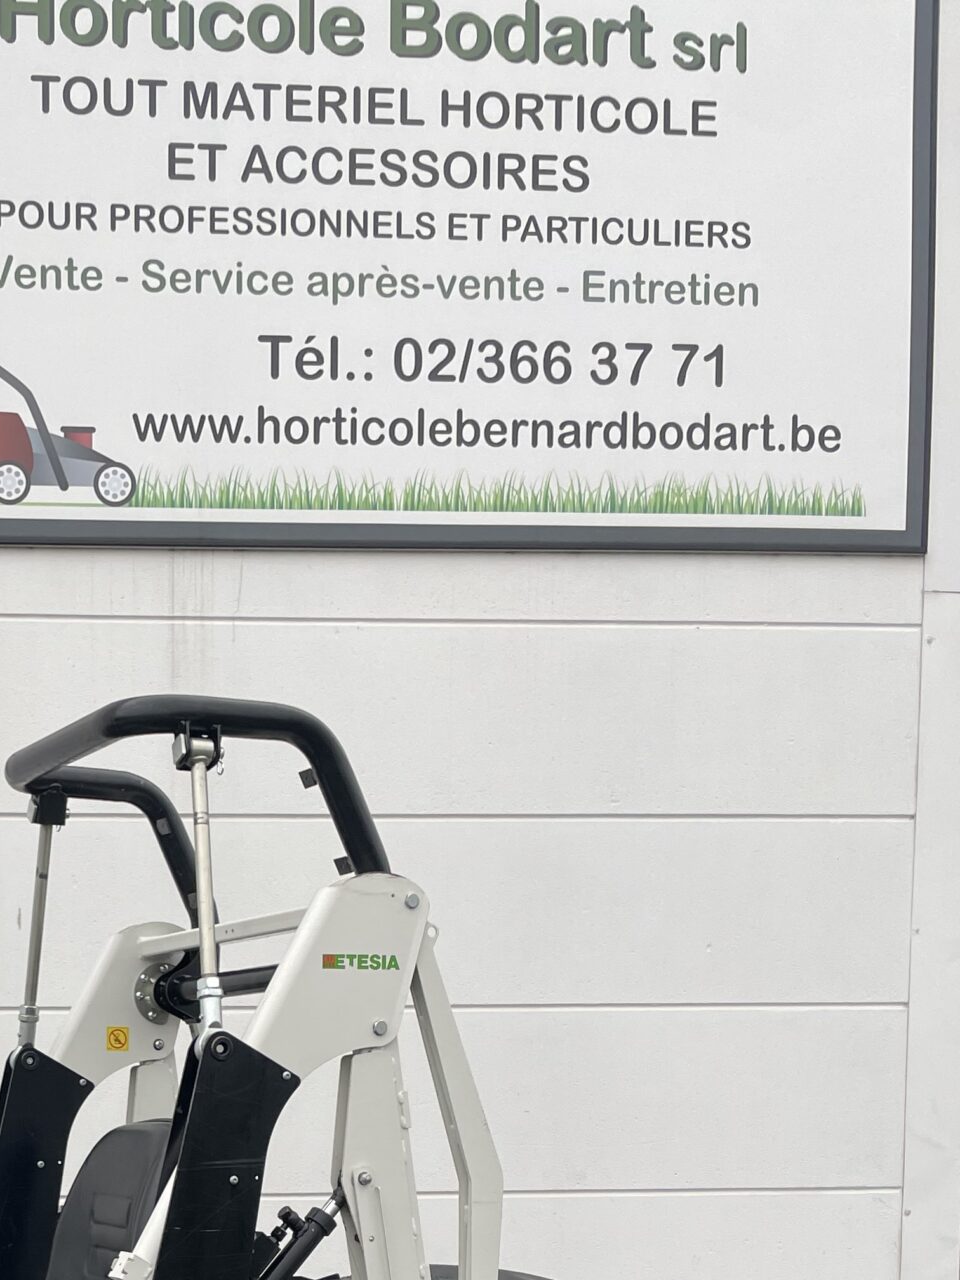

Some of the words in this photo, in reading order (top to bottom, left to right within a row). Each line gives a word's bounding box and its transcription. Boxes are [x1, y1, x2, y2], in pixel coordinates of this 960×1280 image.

[0, 0, 366, 57] Horticole
[389, 0, 658, 69] Bodart
[672, 20, 748, 75] srl
[29, 74, 169, 119] TOUT
[182, 79, 426, 127] MATERIEL
[440, 88, 718, 138] HORTICOLE
[167, 141, 228, 183] ET
[240, 143, 590, 194] ACCESSOIRES
[109, 202, 437, 241] PROFESSIONNELS
[447, 212, 492, 243] ET
[501, 213, 752, 250] PARTICULIERS
[141, 258, 294, 297] Service
[306, 263, 545, 307] après-vente
[582, 267, 759, 308] Entretien
[256, 334, 374, 382] Tél.:
[393, 336, 573, 386] 02/366
[589, 340, 654, 387] 37
[671, 343, 724, 388] 71
[131, 404, 842, 454] www.horticolebernardbodart.be
[323, 953, 400, 970] ETESIA
